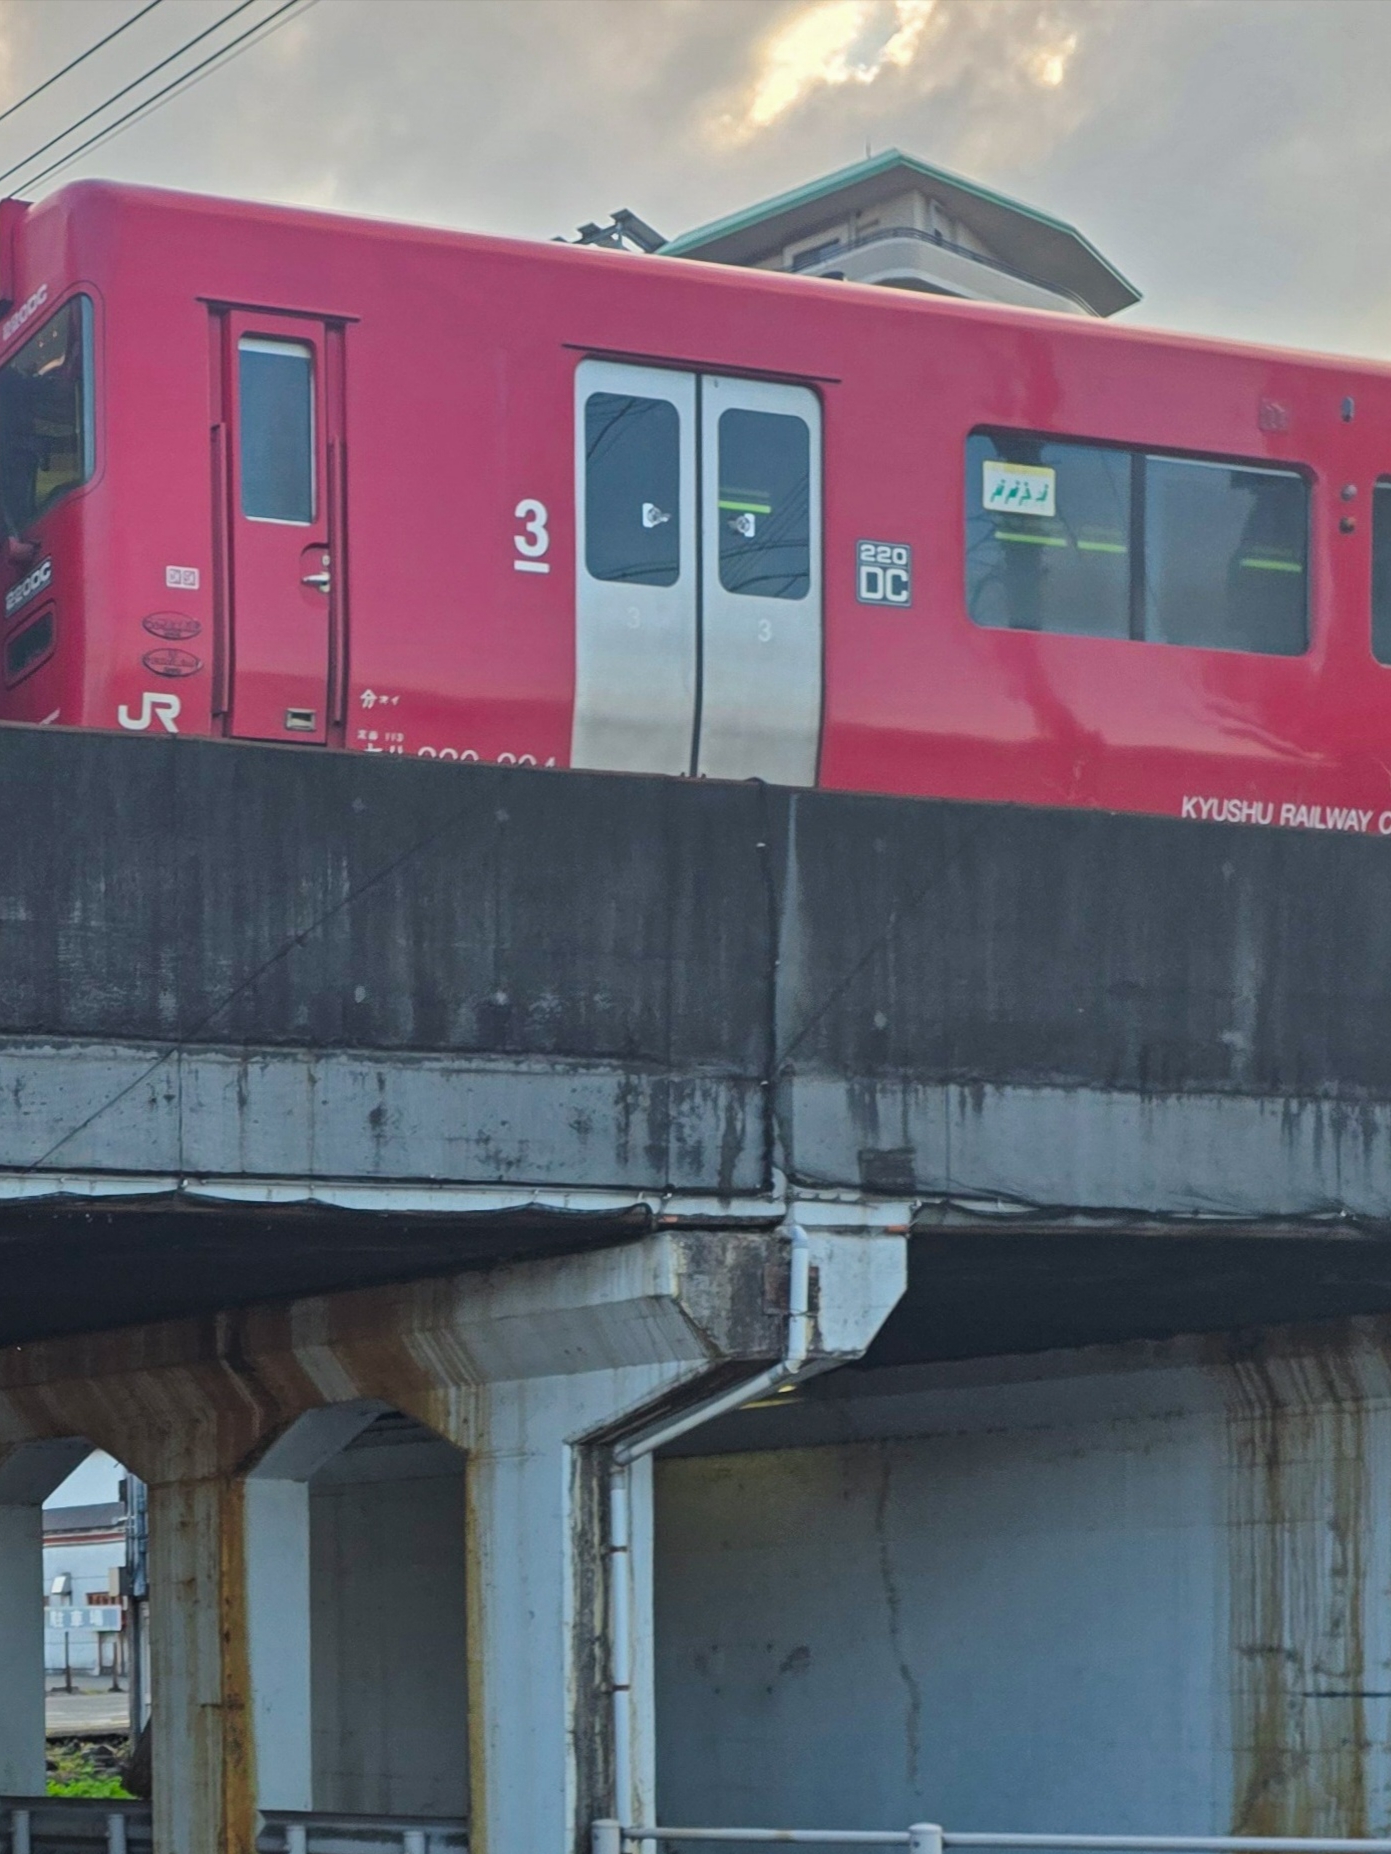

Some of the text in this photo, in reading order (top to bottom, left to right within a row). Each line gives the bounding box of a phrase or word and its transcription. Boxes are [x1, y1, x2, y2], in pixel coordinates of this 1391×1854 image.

[514, 498, 550, 558] 3
[860, 544, 908, 566] 220
[860, 565, 909, 602] DC
[758, 619, 772, 642] 3
[118, 692, 181, 733] JR
[1181, 795, 1274, 825] KYUSHU
[1279, 803, 1374, 833] RAILWAY
